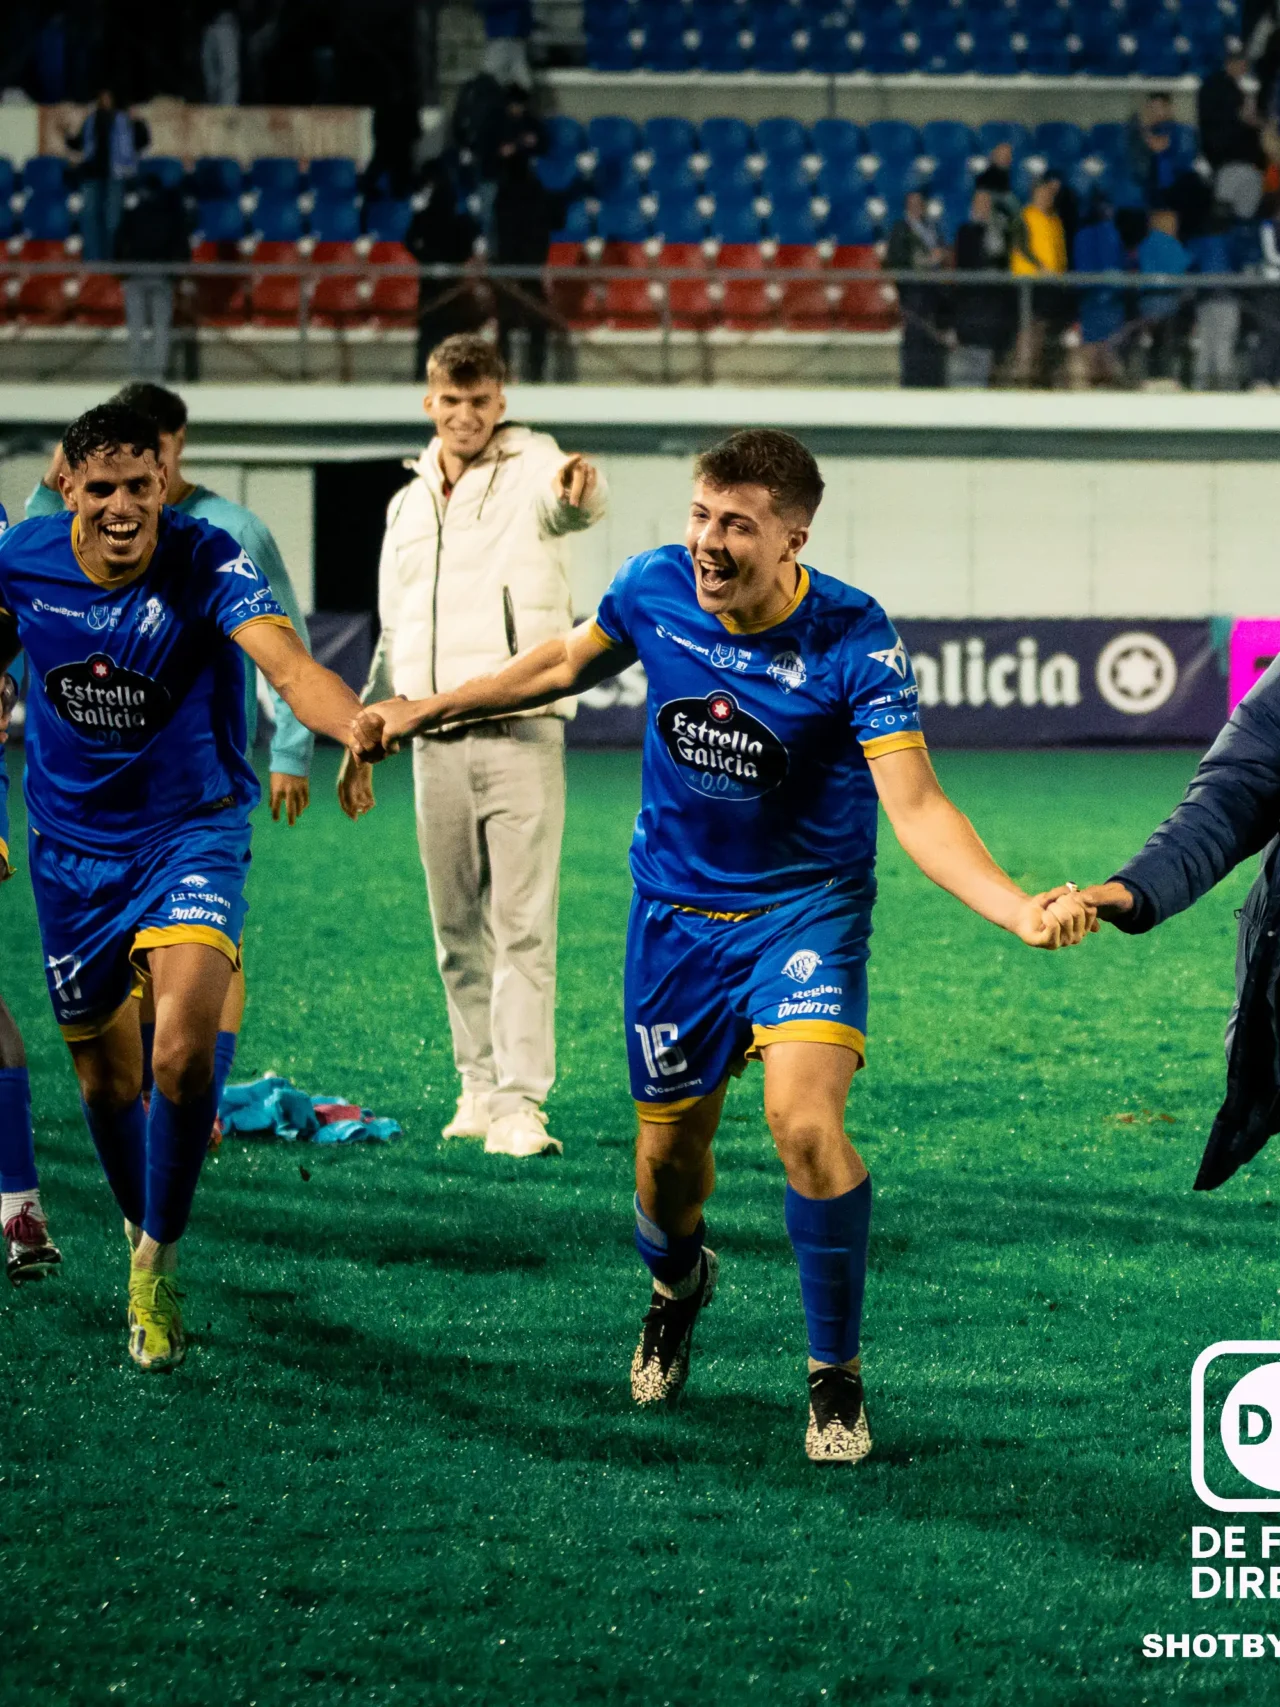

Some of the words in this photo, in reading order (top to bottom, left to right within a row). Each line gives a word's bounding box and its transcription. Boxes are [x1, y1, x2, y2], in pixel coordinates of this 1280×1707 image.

[61, 677, 145, 706] Estrella
[911, 637, 1083, 707] alicia
[67, 700, 146, 728] Galicia
[672, 712, 763, 757] Estrella
[677, 736, 758, 778] Galicia
[634, 1022, 688, 1078] 16
